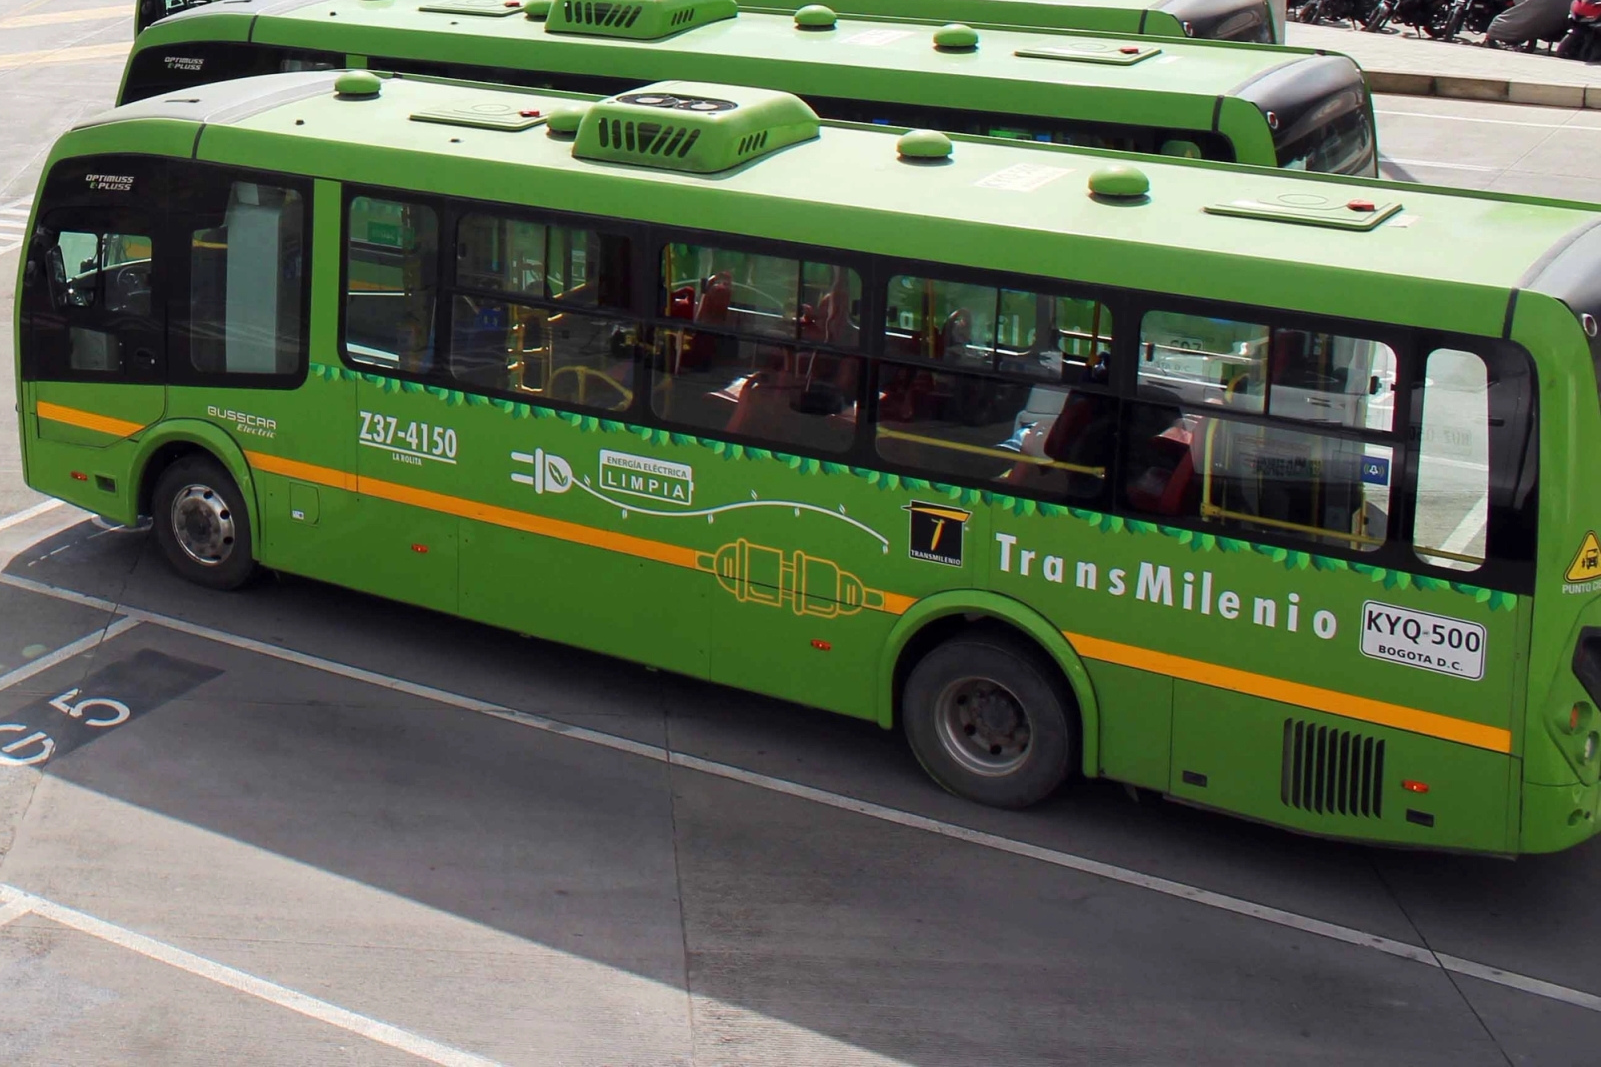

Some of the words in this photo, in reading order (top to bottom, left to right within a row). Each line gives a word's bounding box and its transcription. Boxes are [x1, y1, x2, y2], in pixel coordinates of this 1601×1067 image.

[85, 174, 135, 183] OPTIMUSS
[207, 405, 277, 430] BUSSCAR
[236, 423, 277, 439] Electric
[359, 410, 457, 458] Z37-4150
[392, 453, 400, 461] LA
[401, 454, 423, 466] ROLITA
[606, 456, 642, 470] ENERGÍA
[643, 462, 688, 478] ELÉCTRICA
[607, 471, 685, 500] LIMPIA
[911, 549, 961, 566] TRANSMILENIO
[995, 532, 1338, 639] TransMilenio
[1562, 582, 1592, 594] PUNTO
[1366, 610, 1480, 652] KYQ-500
[1378, 645, 1432, 664] BOGOTA
[1437, 658, 1463, 671] D.C.
